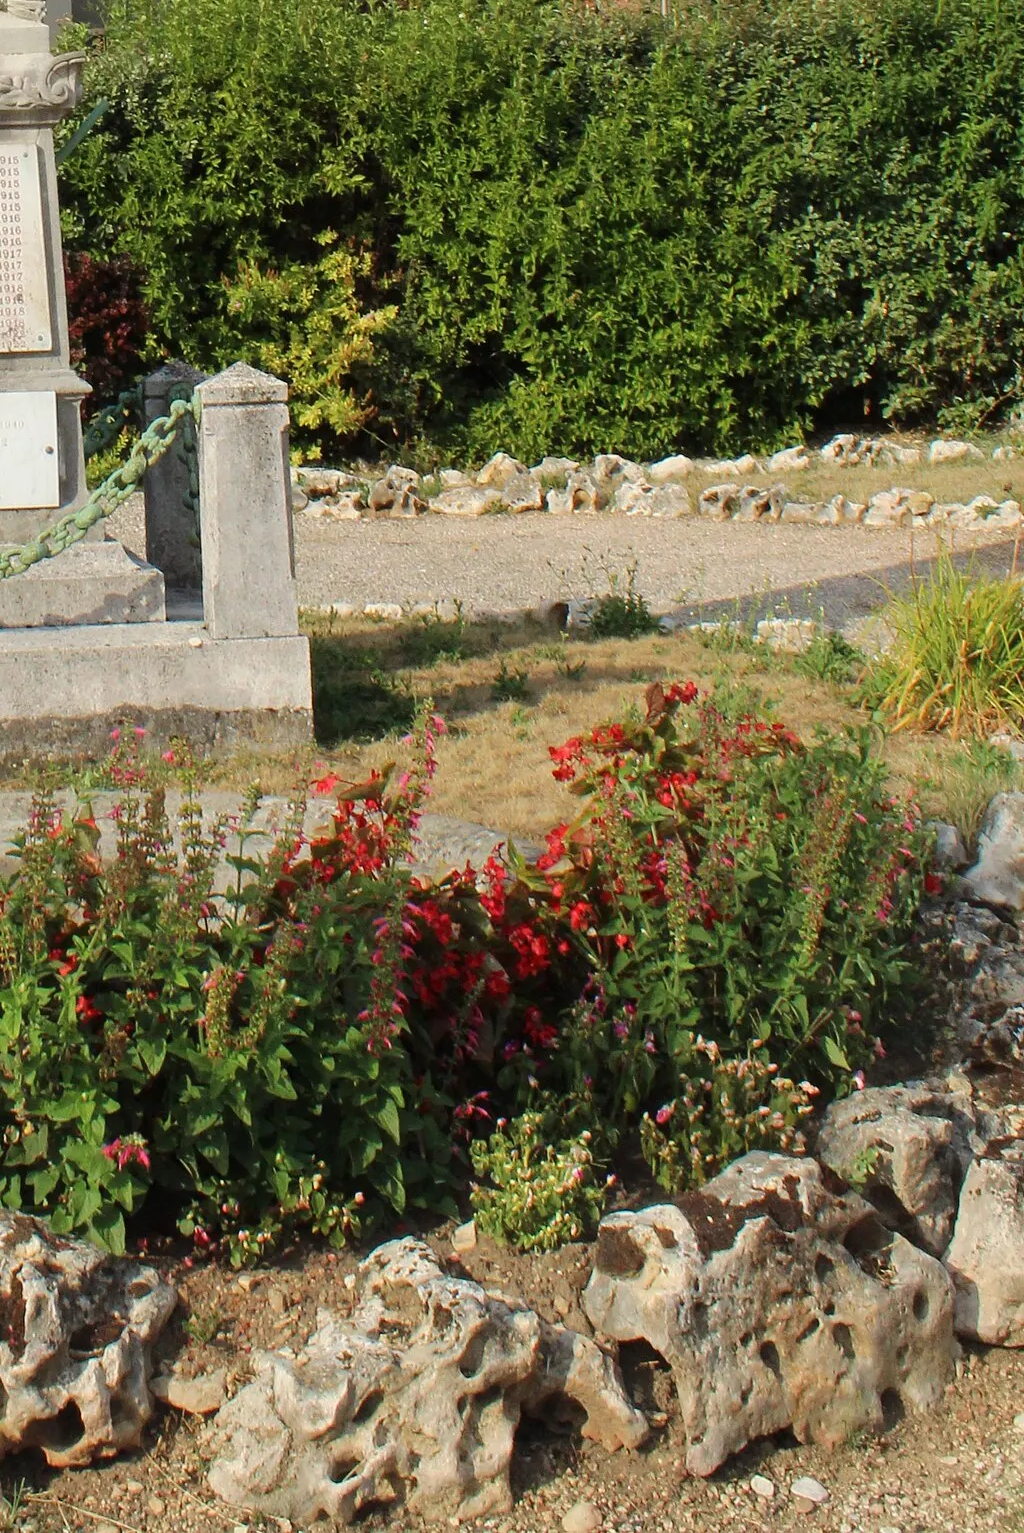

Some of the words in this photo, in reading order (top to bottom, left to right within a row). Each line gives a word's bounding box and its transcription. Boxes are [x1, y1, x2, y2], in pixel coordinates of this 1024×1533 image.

[0, 273, 23, 282] 1917
[0, 284, 24, 293] 1918
[0, 307, 26, 317] 1918
